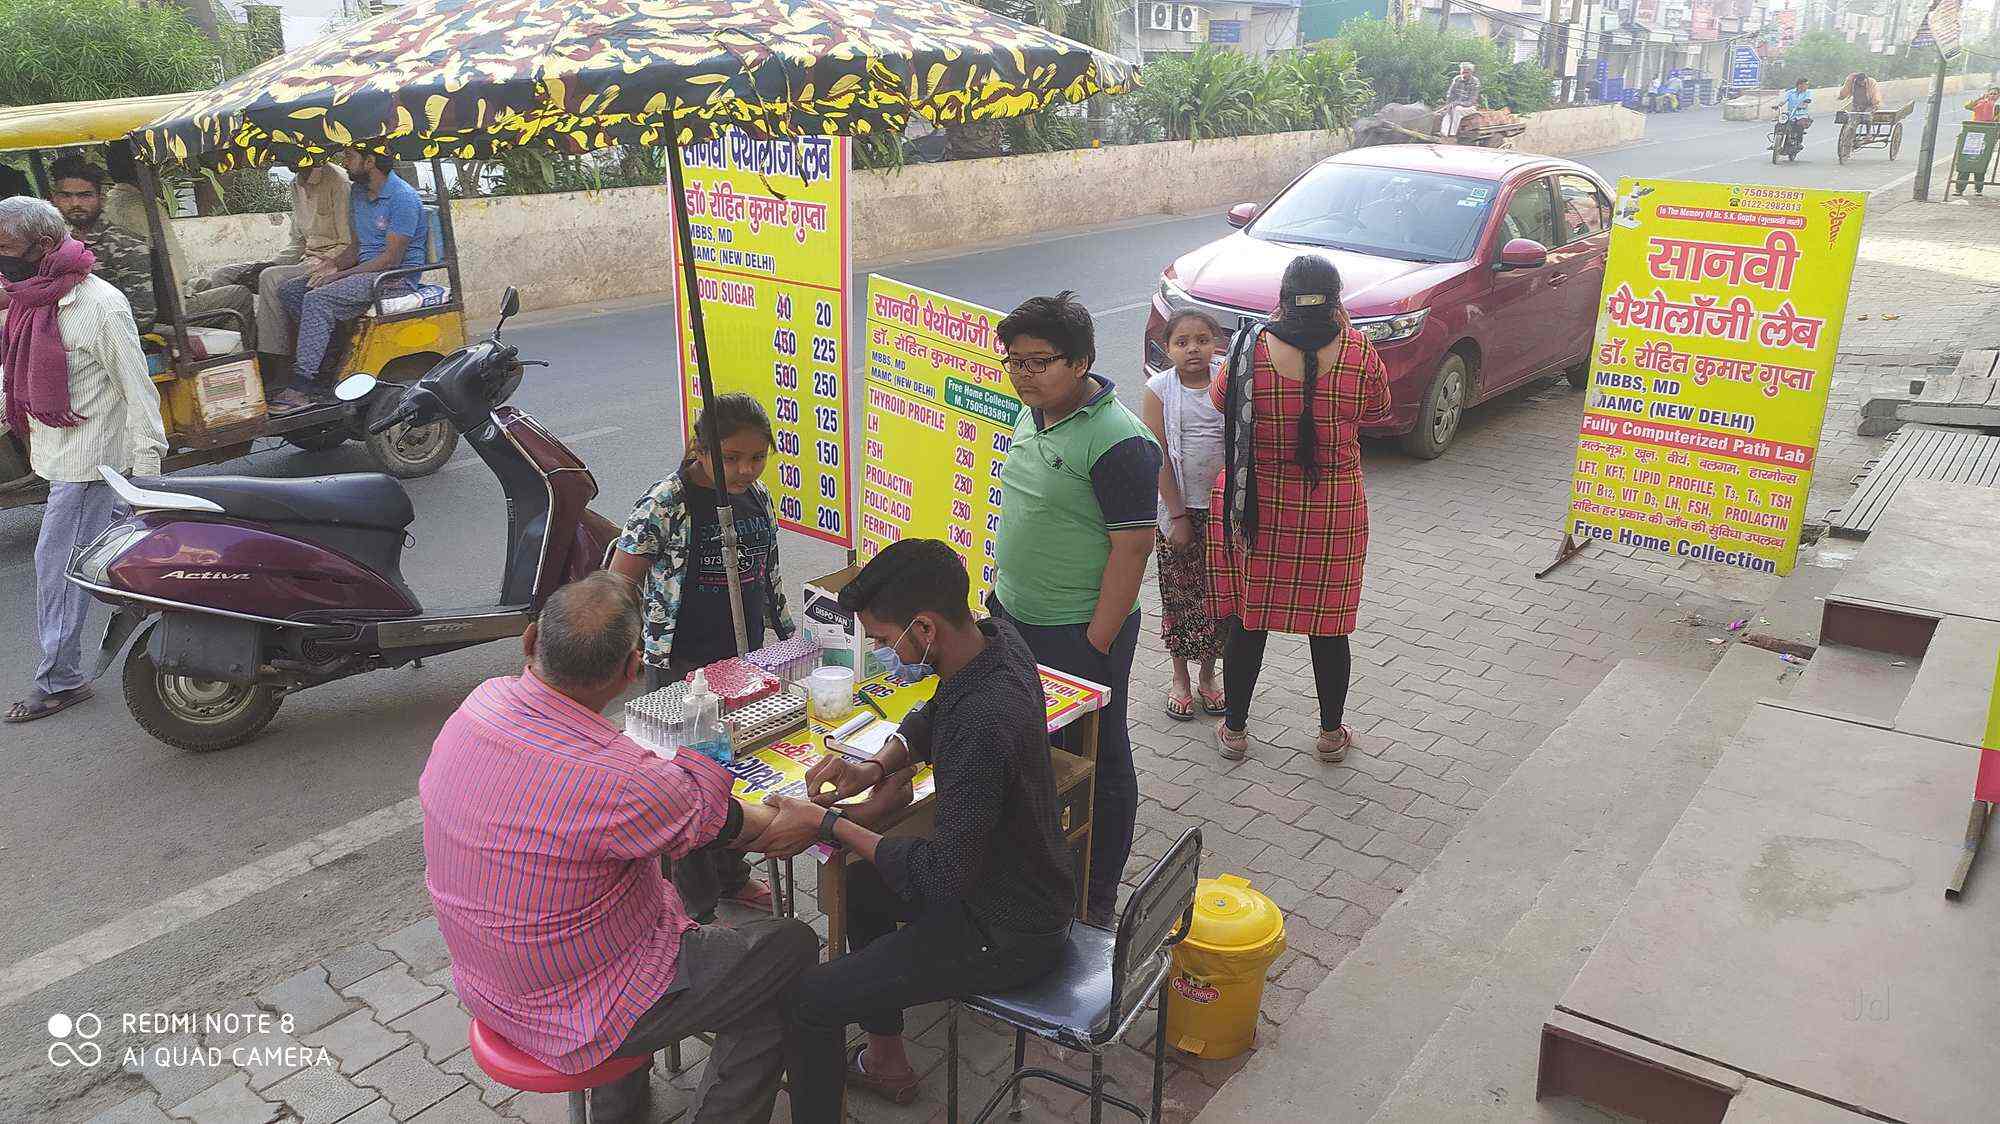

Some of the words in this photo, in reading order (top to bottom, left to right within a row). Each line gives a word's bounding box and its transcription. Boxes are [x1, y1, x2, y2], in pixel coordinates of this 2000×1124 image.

[709, 183, 745, 221] रोहित
[748, 196, 788, 233] कुमार
[790, 202, 826, 242] गुप्ता
[1680, 208, 1704, 220] Memory
[718, 228, 732, 243] MD
[720, 249, 741, 266] (NEW
[745, 253, 775, 274] DELHI)
[1649, 231, 1801, 290] सानवी
[698, 279, 718, 300] OOD
[721, 282, 755, 307] SUGAR
[816, 302, 832, 327] 20
[875, 293, 920, 327] सानवी
[922, 298, 990, 348] पैथोलॉजी
[1608, 285, 1754, 340] पैथोलॉजी
[1760, 302, 1822, 349] लैब
[813, 337, 836, 363] 225
[895, 358, 906, 371] MD
[930, 348, 968, 371] कुमार
[970, 361, 1004, 384] गुप्ता
[1600, 338, 1627, 364] डॉ.
[1635, 341, 1691, 372] रोहित
[1694, 355, 1757, 385] कुमार
[1760, 364, 1816, 397] गुप्ता
[814, 372, 837, 398] 250
[948, 379, 963, 393] Free
[964, 385, 983, 400] Home
[984, 391, 1019, 412] Collection
[1595, 372, 1647, 393] MBBS,
[1653, 379, 1680, 395] MD
[815, 406, 838, 432] 125
[868, 413, 879, 432] LH
[869, 388, 906, 416] THYROID
[908, 402, 945, 431] PROFILE
[1650, 401, 1694, 420] (NEW
[1699, 409, 1755, 433] DELHI)
[816, 441, 839, 466] 150
[867, 439, 883, 460] FSH
[1583, 416, 1618, 435] Fully
[1622, 422, 1728, 450] Computerized
[1733, 439, 1771, 458] Path
[1775, 446, 1805, 463] Lab
[820, 474, 836, 499] 90
[866, 464, 913, 497] PROLACTIN
[1579, 461, 1598, 476] LFT,
[1633, 469, 1661, 485] LIPID
[1668, 475, 1716, 497] PROFILE,
[1770, 493, 1793, 509] TSH
[818, 506, 840, 532] 200
[864, 488, 889, 513] FOLIC
[890, 500, 911, 522] ACID
[1573, 499, 1601, 513] सहित
[1601, 505, 1617, 516] हर
[1648, 512, 1664, 524] की
[1690, 519, 1707, 532] की
[1575, 480, 1592, 494] VIT
[1622, 487, 1639, 502] VIT
[1688, 499, 1712, 519] FSH,
[1725, 507, 1789, 531] PROLACTIN
[864, 513, 901, 542] FERRITIN
[863, 537, 879, 557] PTH
[1574, 520, 1613, 540] Free
[1619, 528, 1671, 554] Home
[1677, 539, 1776, 574] Collection
[815, 606, 834, 620] DISPO
[834, 615, 848, 627] VAN
